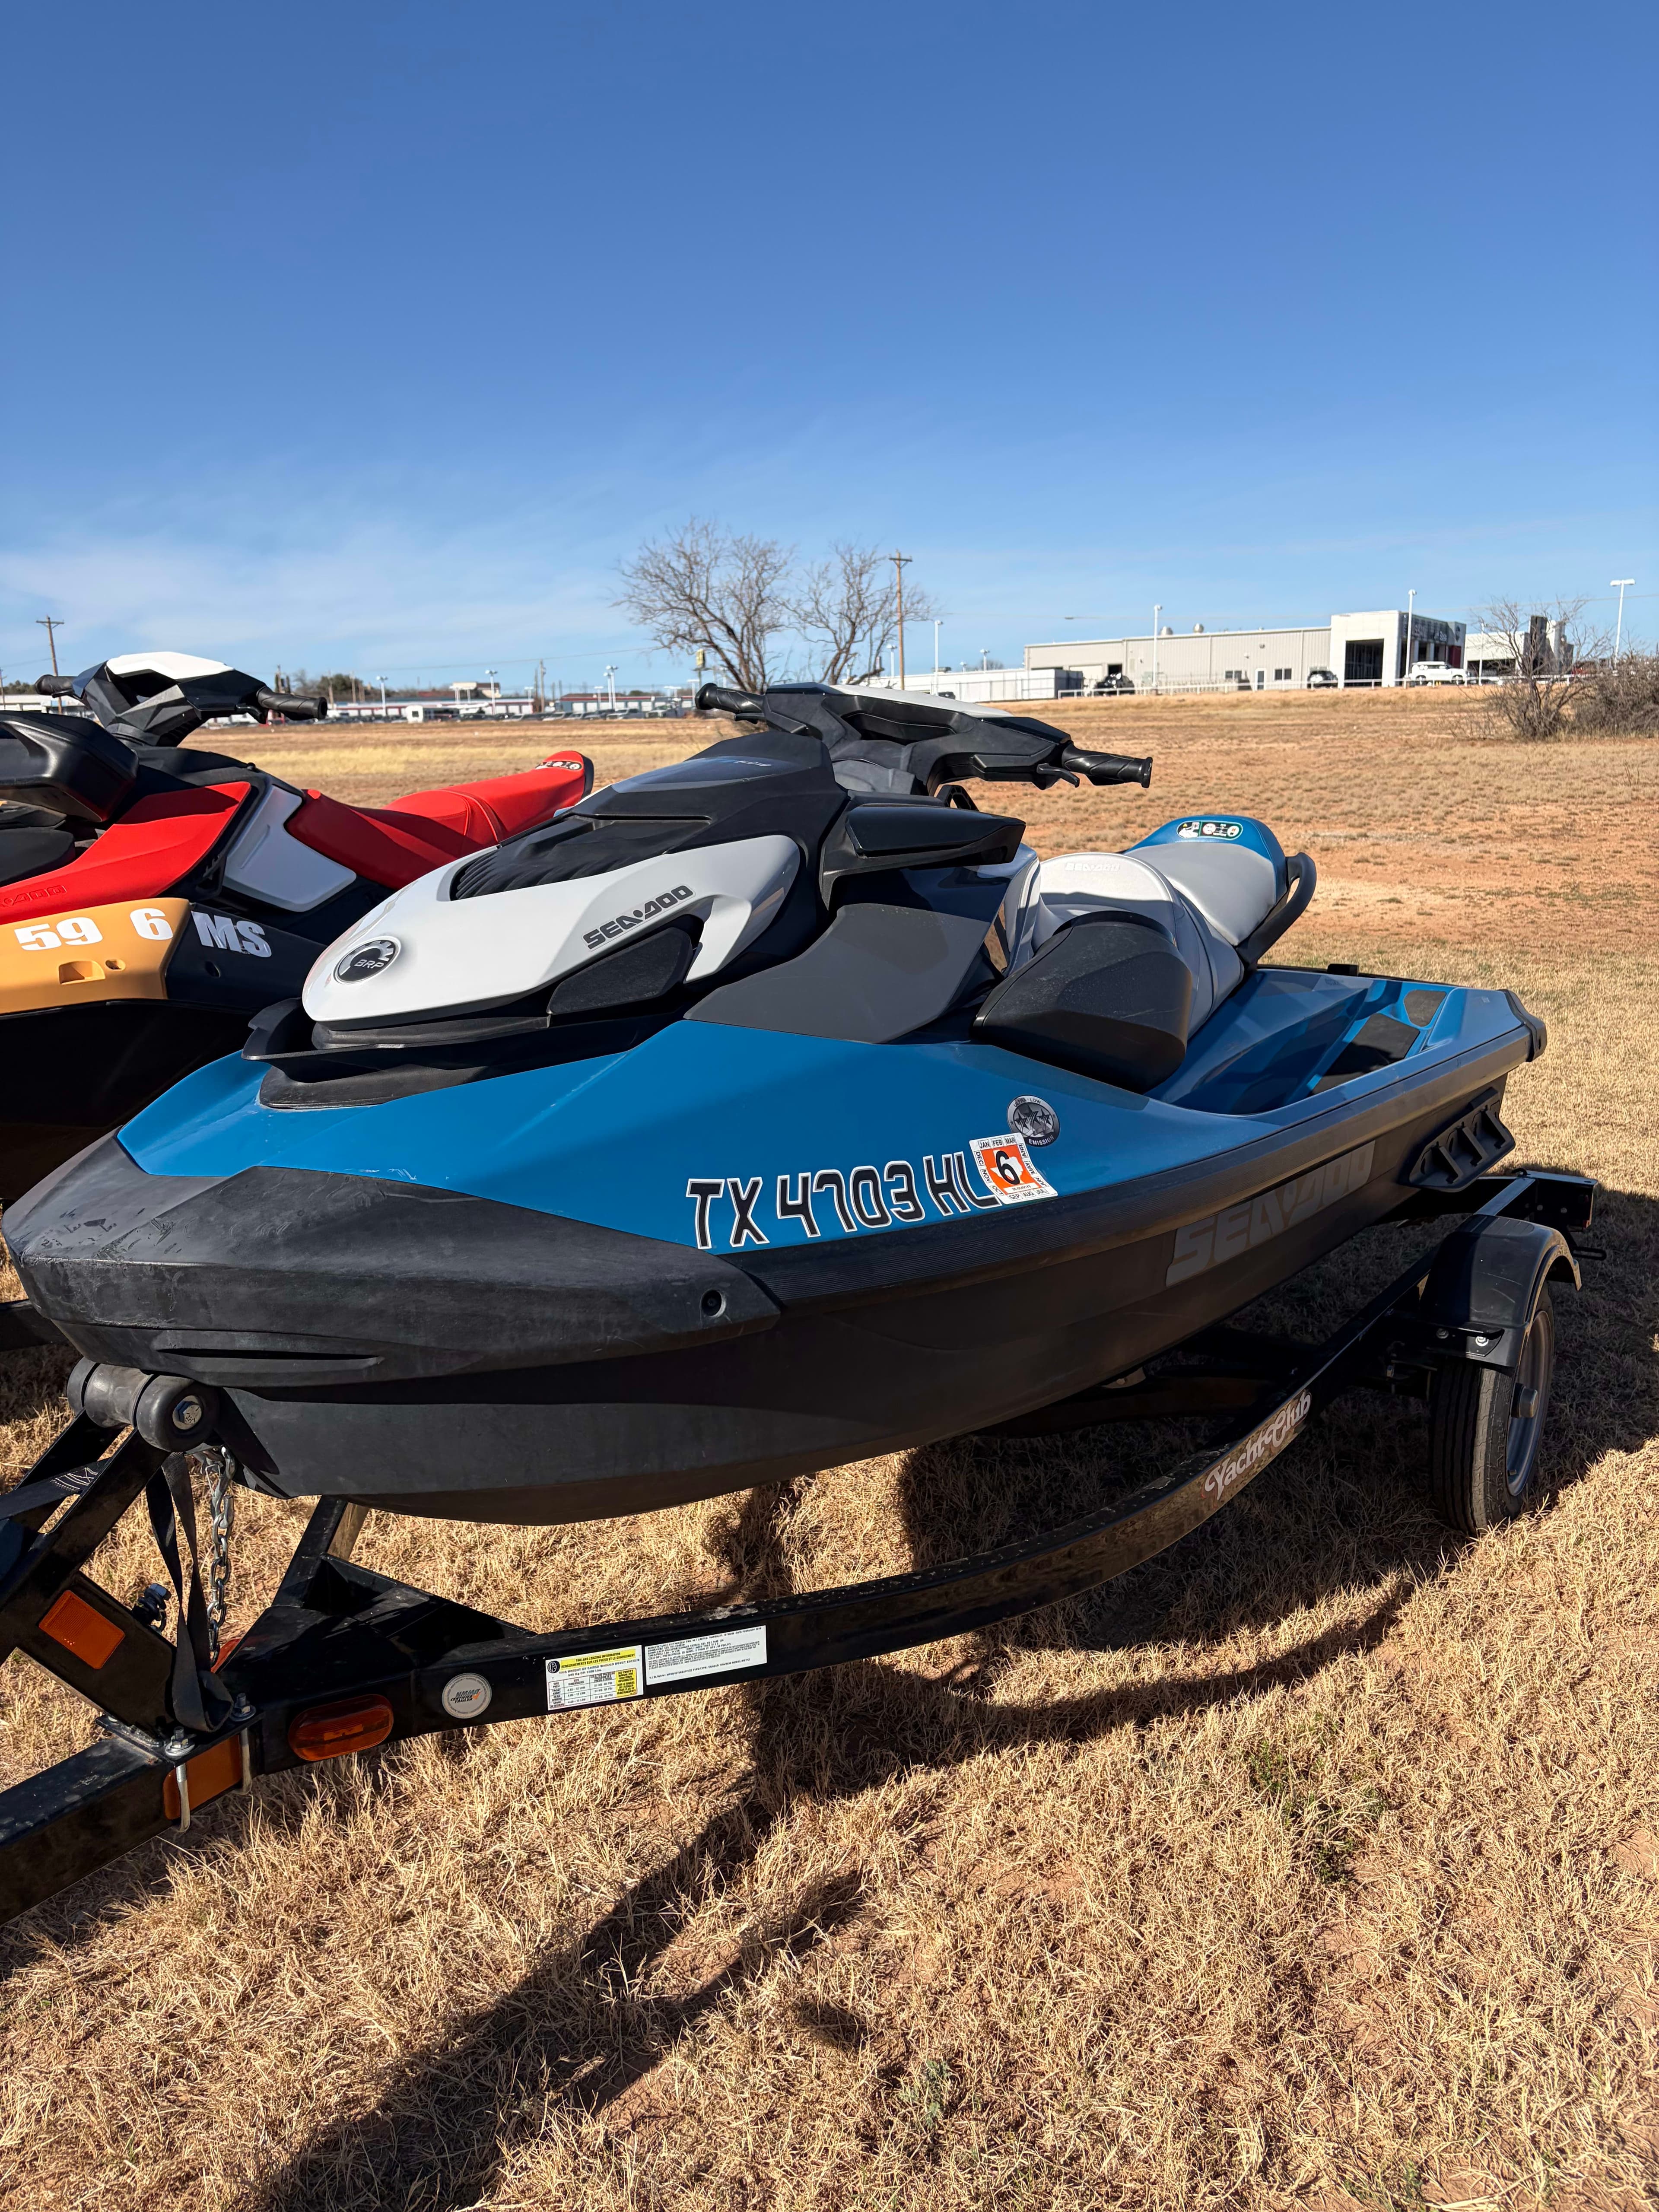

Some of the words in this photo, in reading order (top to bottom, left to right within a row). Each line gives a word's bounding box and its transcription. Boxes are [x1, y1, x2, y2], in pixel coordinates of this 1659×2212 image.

[14, 916, 104, 951] 59
[130, 908, 173, 941] 6
[191, 910, 273, 958] MS
[353, 959, 385, 969] BRP
[1014, 1097, 1027, 1107] ULTRA
[979, 1140, 990, 1149] JAN
[1028, 1135, 1054, 1145] EMISSION
[975, 1151, 984, 1166] DEC
[996, 1150, 1020, 1185] 6
[1025, 1162, 1036, 1175] MAY
[982, 1170, 992, 1183] NOV
[1036, 1177, 1047, 1187] JUN
[992, 1185, 1004, 1195] OCT
[686, 1177, 769, 1249] TX
[777, 1160, 924, 1237] 4703
[923, 1151, 1002, 1216] HL
[1204, 1429, 1265, 1501] Yacht
[1264, 1390, 1311, 1447] Club
